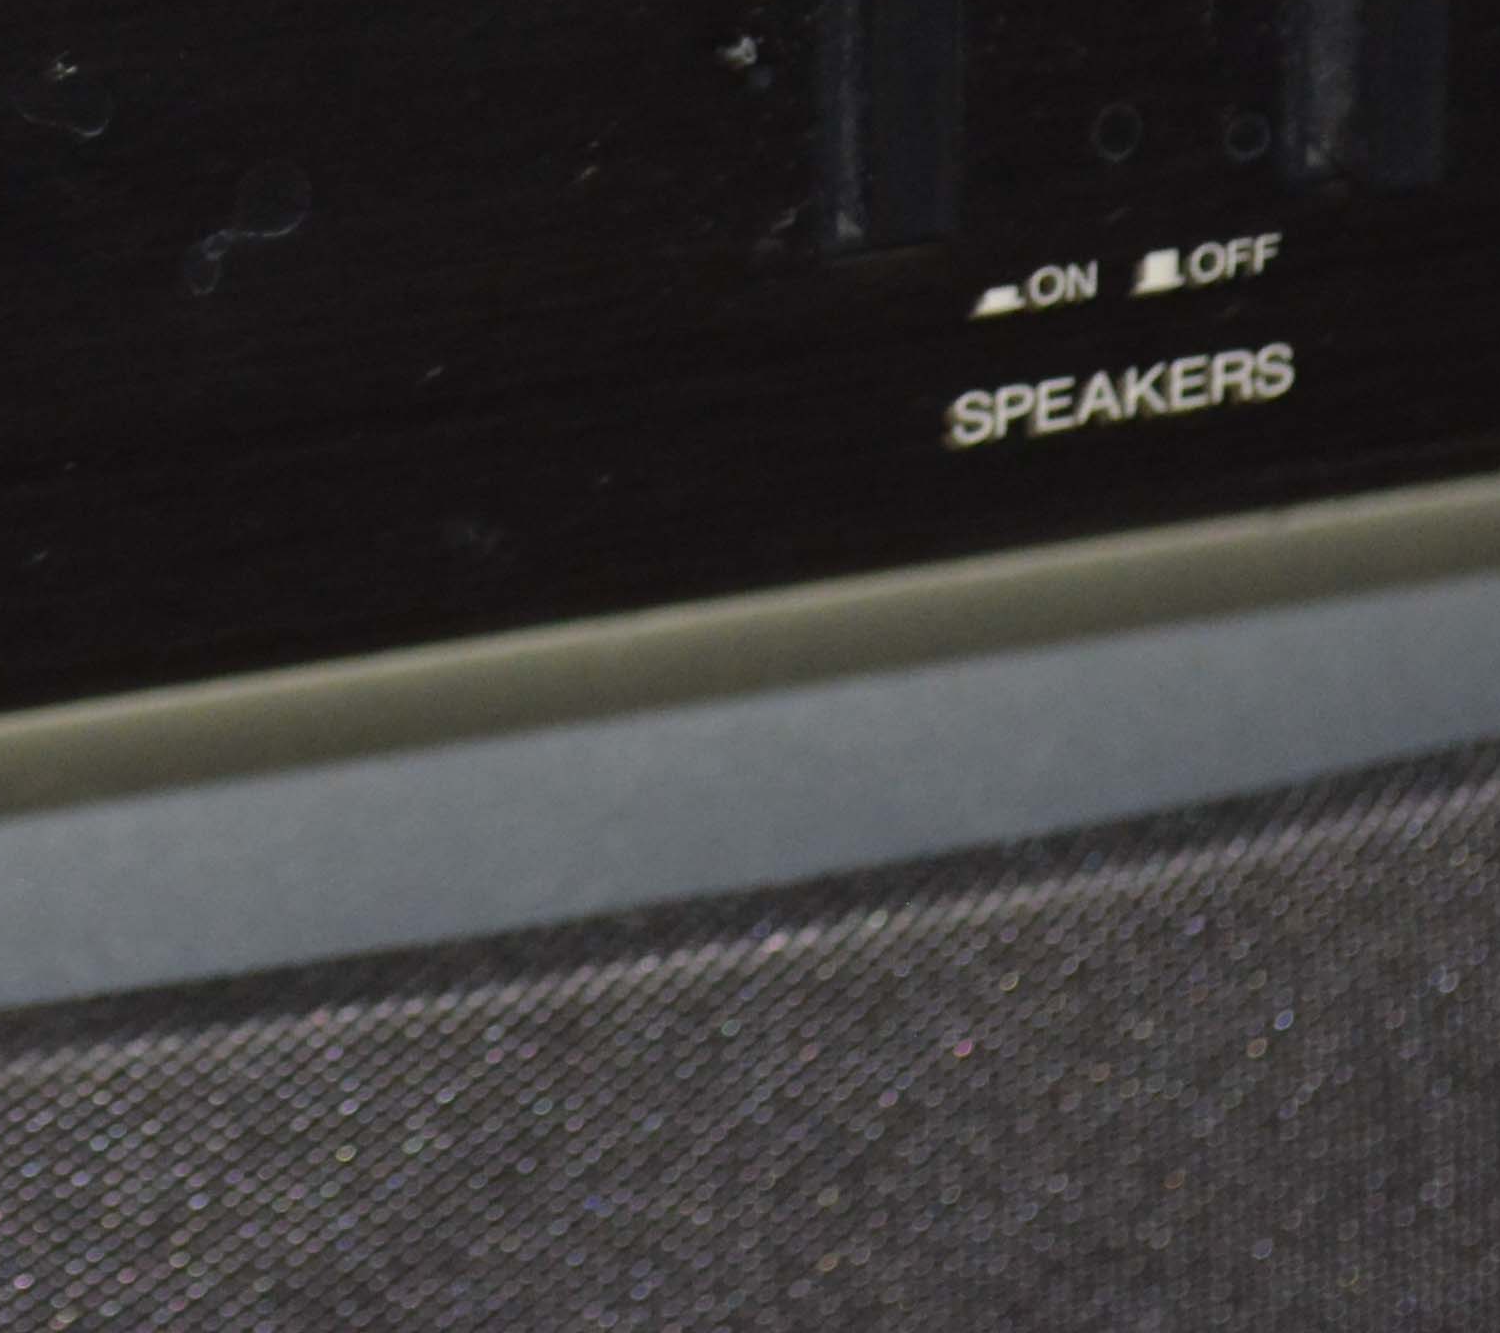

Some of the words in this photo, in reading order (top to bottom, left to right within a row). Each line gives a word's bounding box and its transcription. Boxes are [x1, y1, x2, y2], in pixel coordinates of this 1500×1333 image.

[1024, 263, 1100, 307] ON
[1184, 235, 1284, 285] OFF
[948, 345, 1296, 447] SPEAKERS
